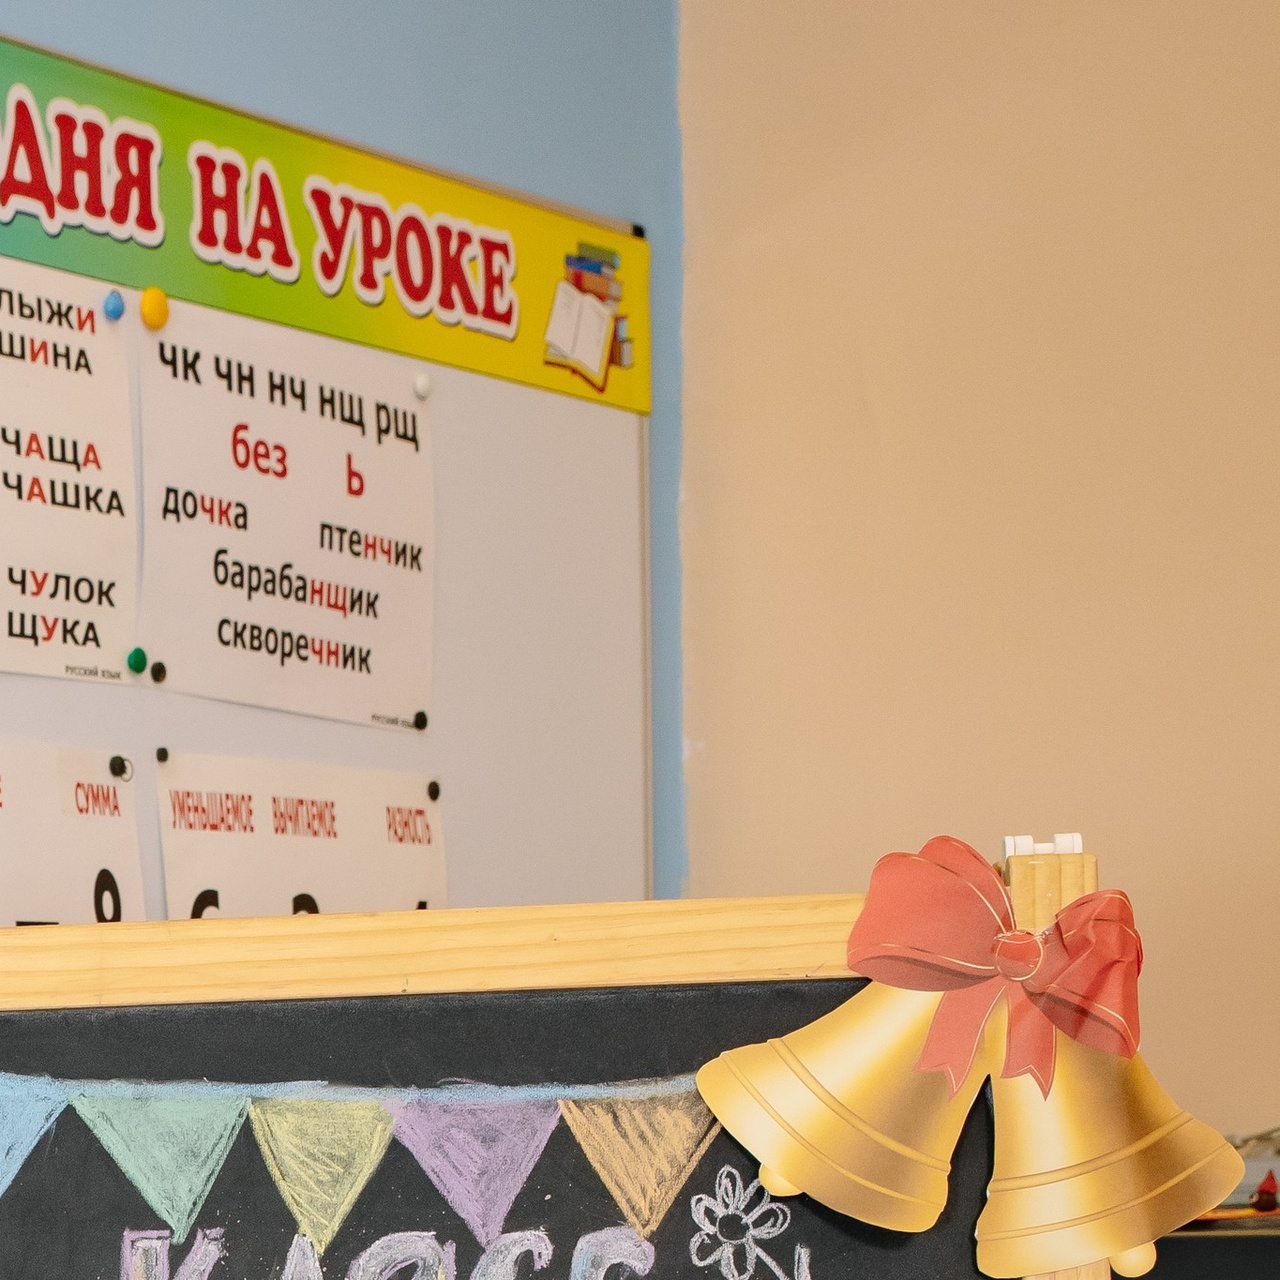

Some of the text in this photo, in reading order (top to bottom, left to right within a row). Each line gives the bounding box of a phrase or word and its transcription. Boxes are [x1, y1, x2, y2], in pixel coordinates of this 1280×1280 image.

[195, 154, 295, 268] НА
[309, 187, 515, 327] УРОКЕ
[1, 426, 102, 472] ЧАЩА
[231, 423, 289, 480] без
[2, 471, 126, 518] ЧАШКА
[162, 485, 249, 531] дочка
[319, 521, 424, 573] птенчик
[8, 566, 117, 608] ЧУЛОК
[213, 548, 380, 620] барабанщик
[7, 611, 102, 648] ЩУКА
[217, 617, 372, 675] скворечник
[75, 781, 122, 817] СУММА
